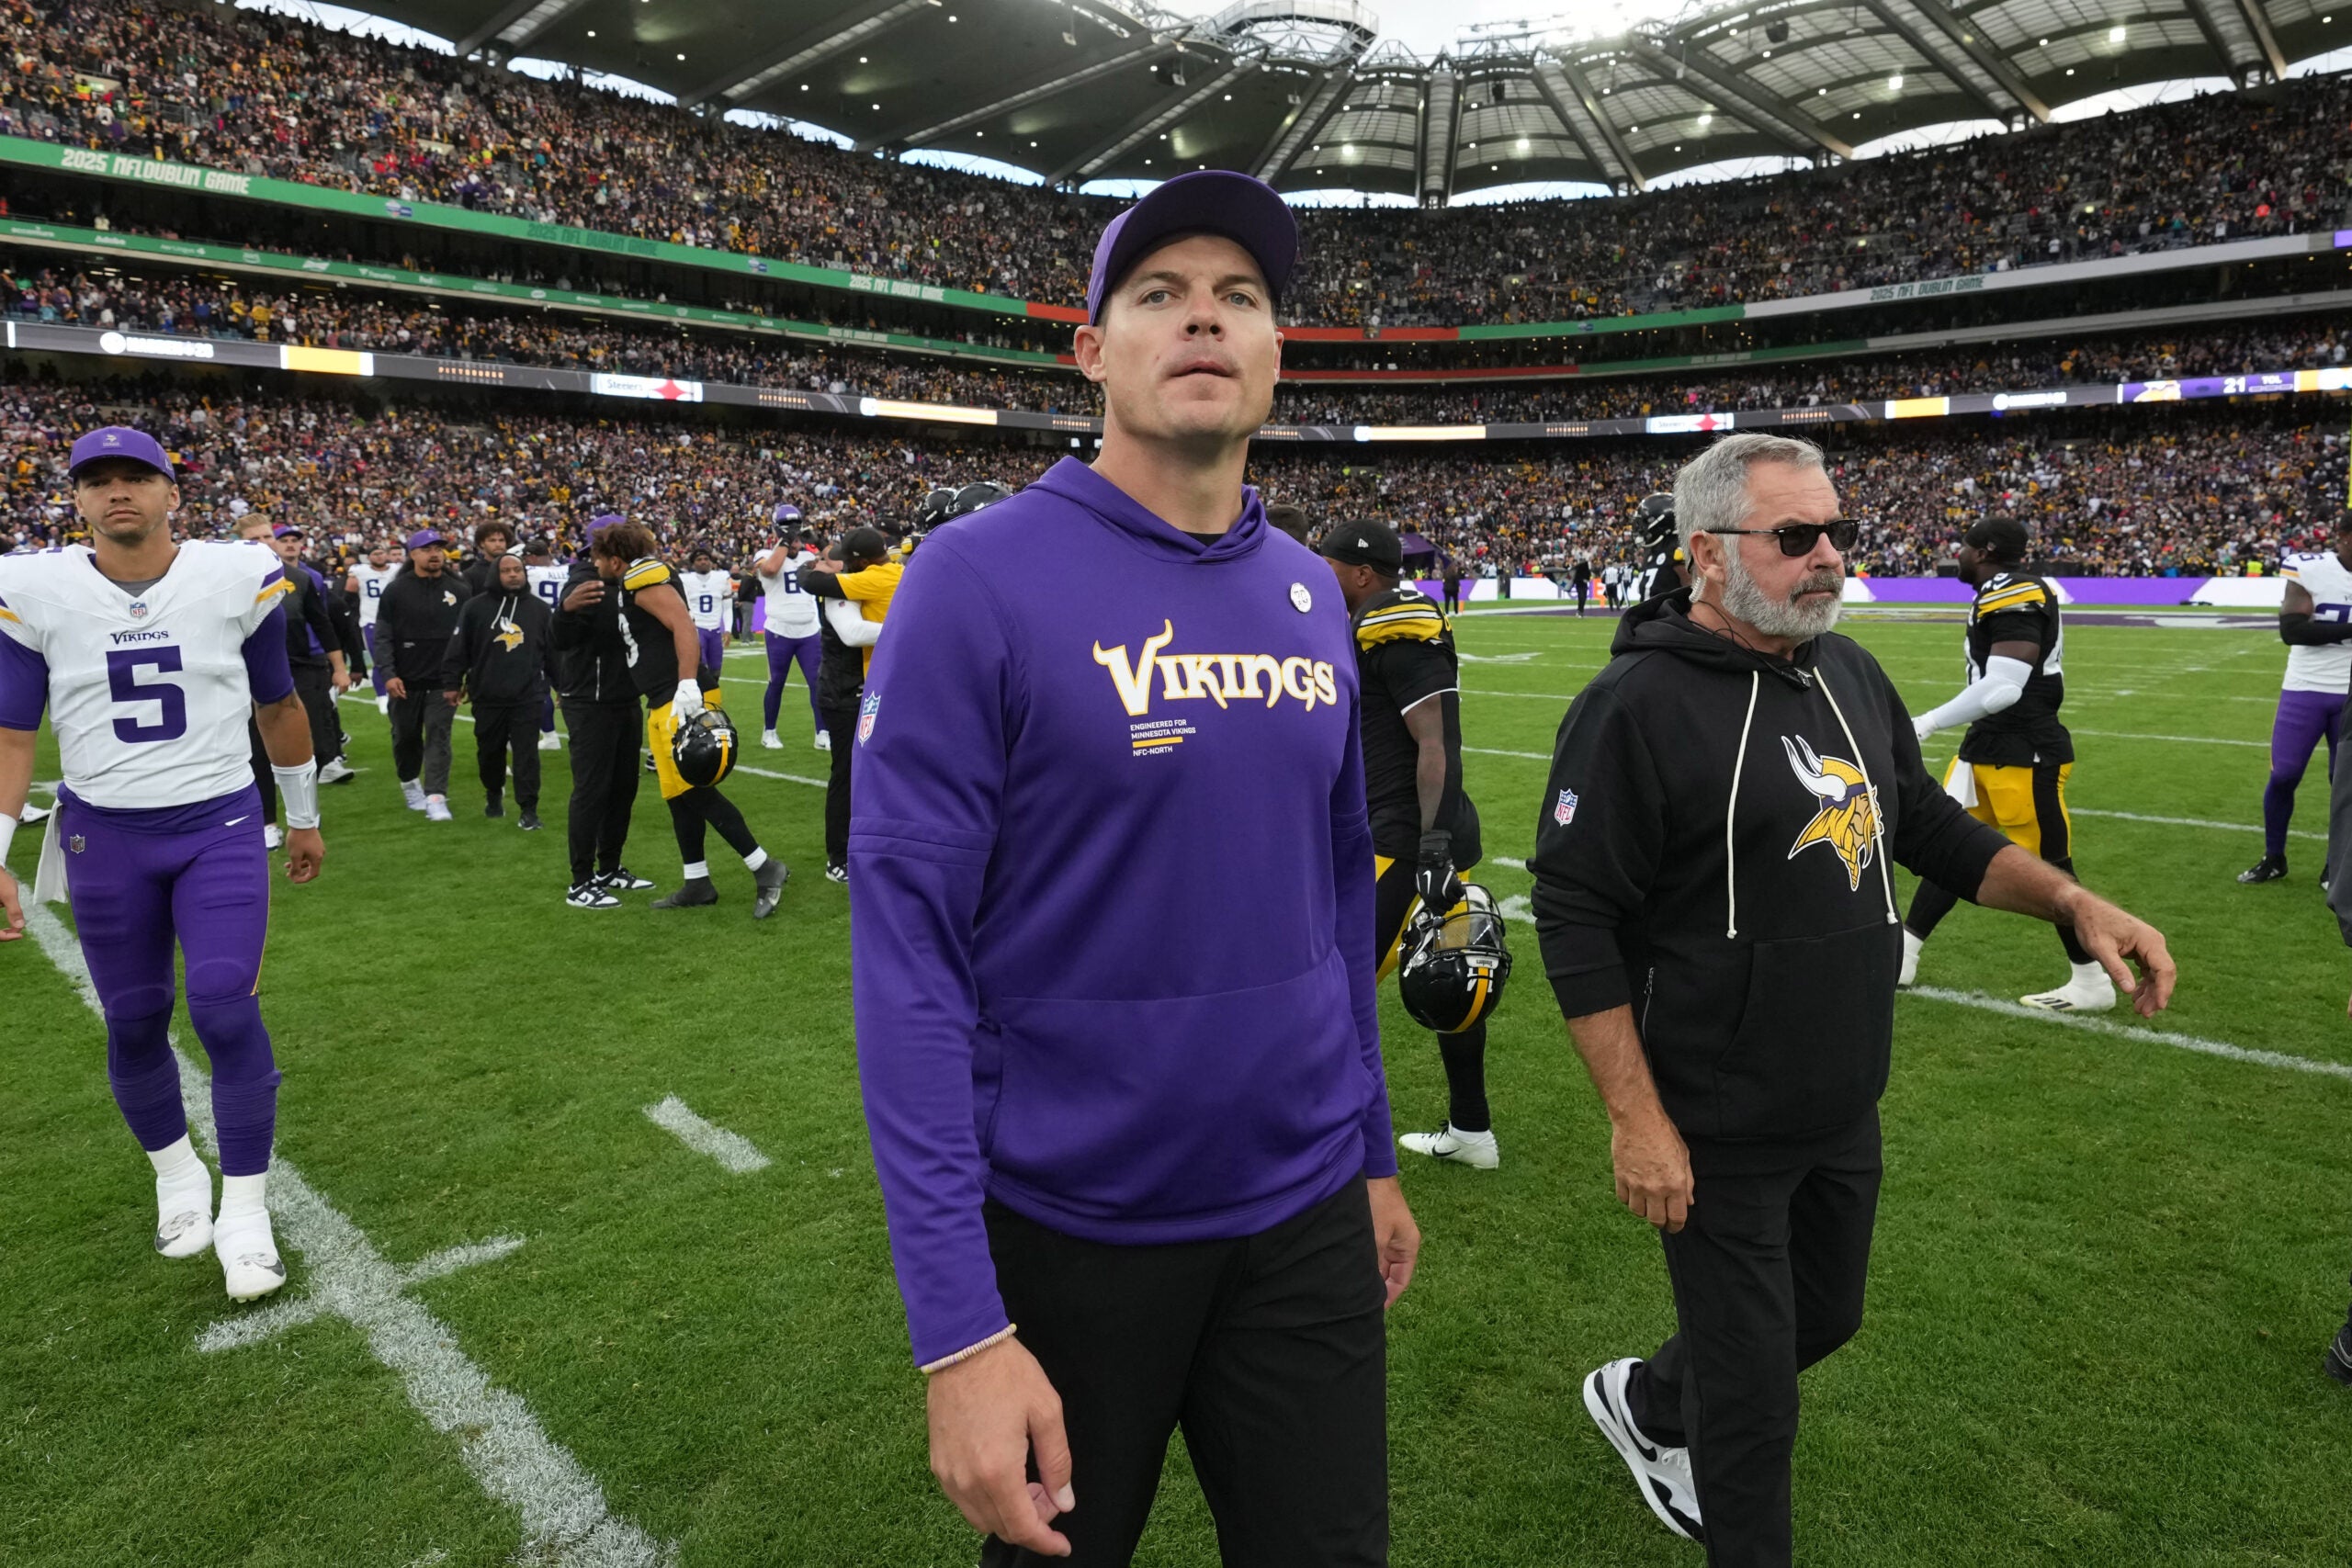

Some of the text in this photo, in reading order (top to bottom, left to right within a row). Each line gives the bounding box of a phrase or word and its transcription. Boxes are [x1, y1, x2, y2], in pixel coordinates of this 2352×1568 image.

[61, 148, 108, 172] 2025
[205, 171, 252, 195] GAME
[849, 274, 945, 302] 2025 NFL DUBLIN GAME
[1870, 276, 1984, 301] 2025 NFL DUBLIN GAME
[2223, 378, 2246, 394] 21
[548, 571, 571, 580] ALLE
[366, 579, 380, 598] 6
[538, 580, 560, 609] 9
[131, 608, 147, 617] NFL
[699, 594, 713, 614] 8
[106, 645, 187, 744] 5
[1129, 718, 1187, 731] ENGINEERED FOR
[1131, 727, 1196, 740] MINNESOTA VIKINGS
[1133, 745, 1173, 757] NFC-NORTH
[1556, 803, 1572, 821] NFL
